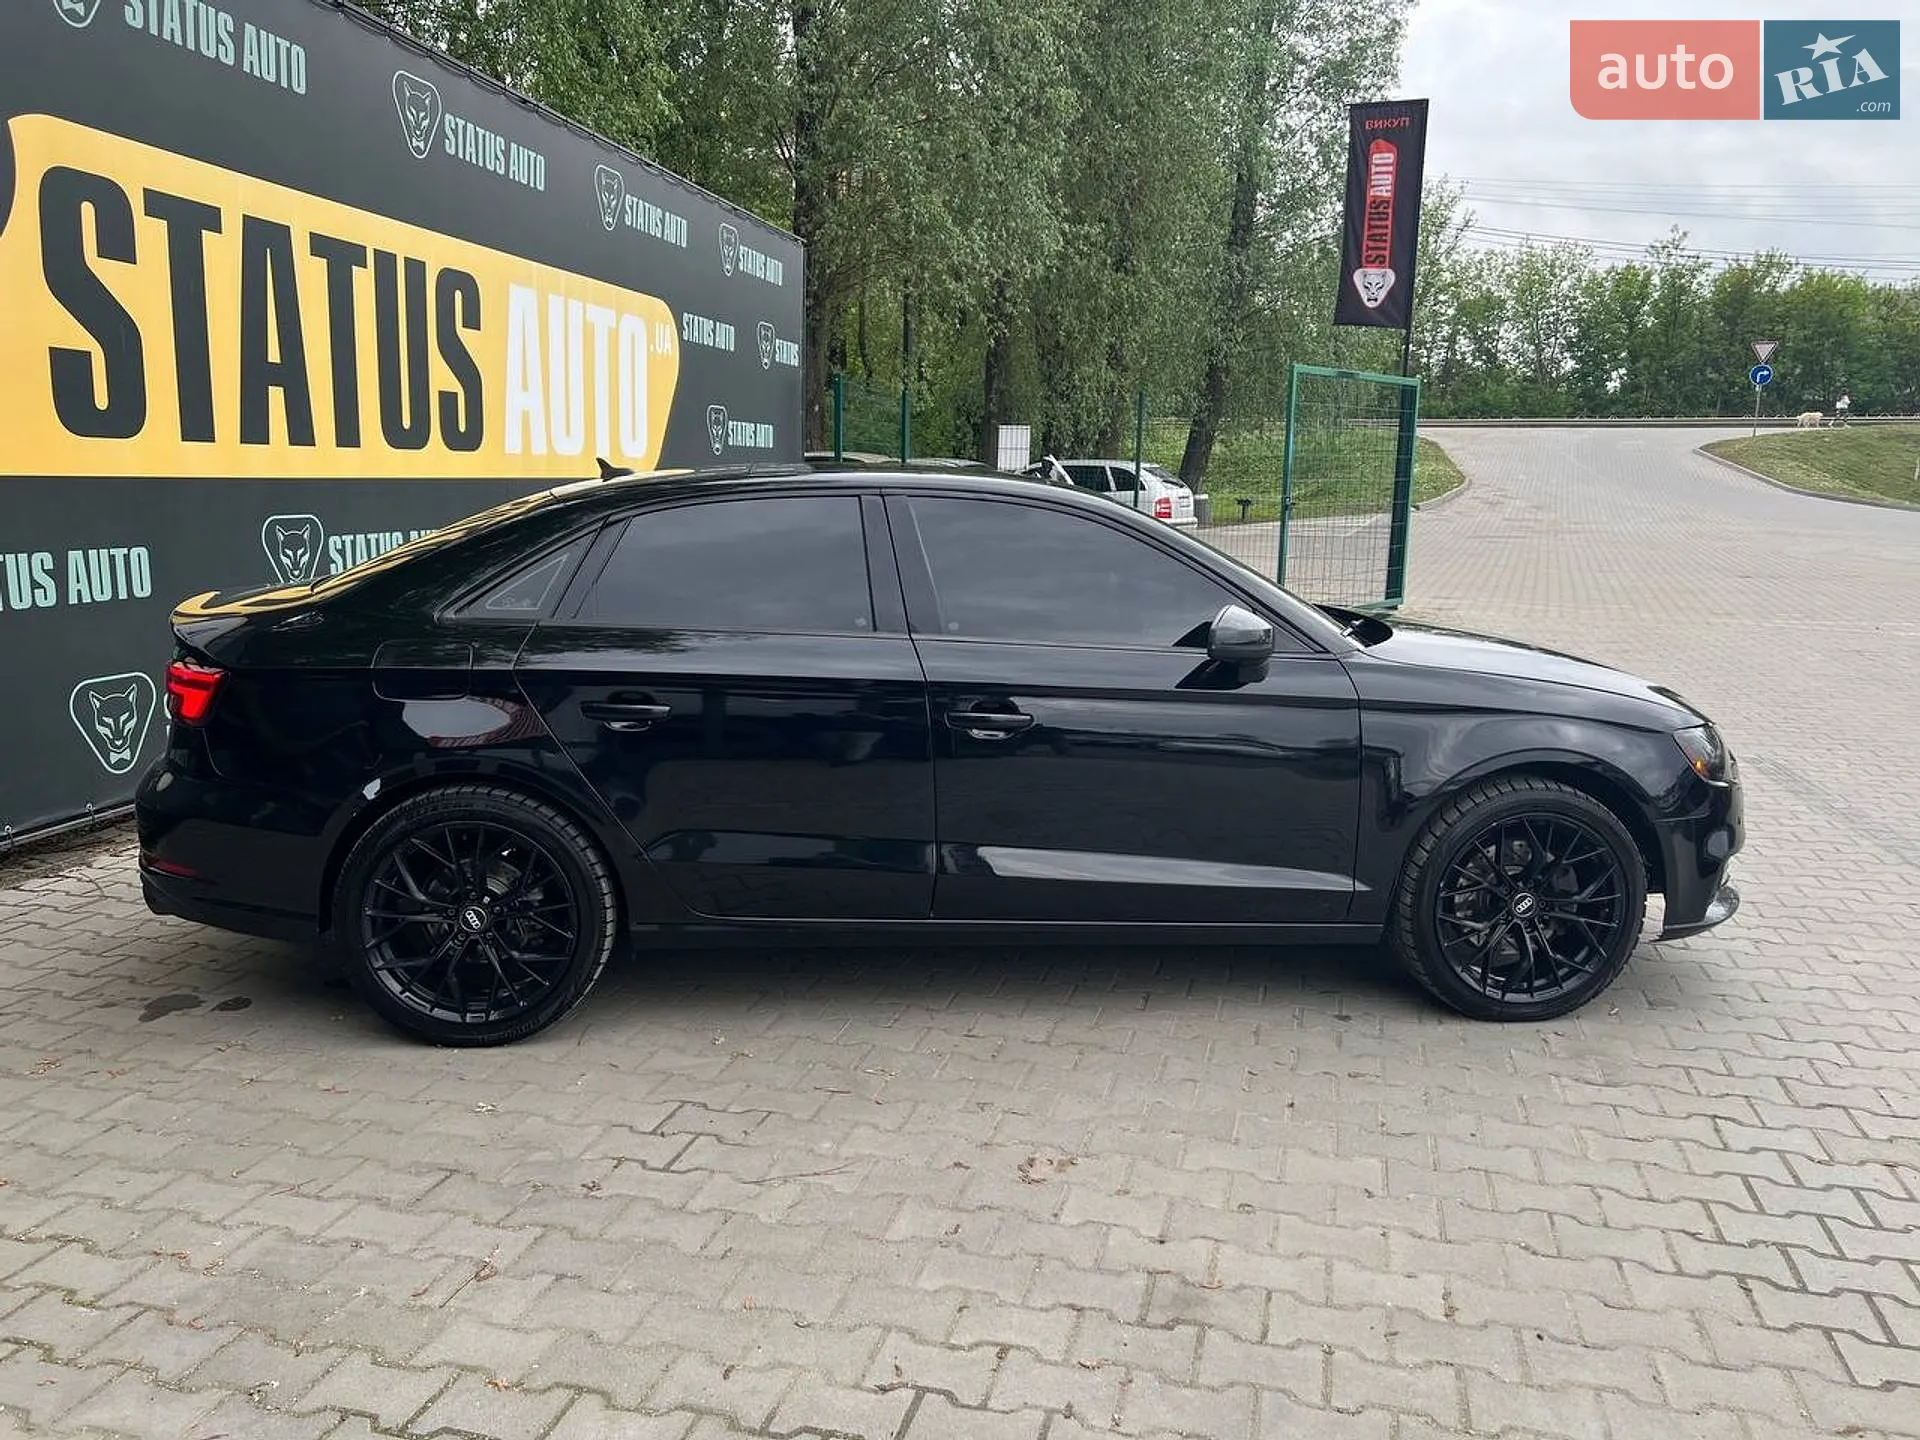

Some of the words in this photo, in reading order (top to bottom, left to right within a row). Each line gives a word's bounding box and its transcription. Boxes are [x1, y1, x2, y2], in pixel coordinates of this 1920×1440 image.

[242, 22, 306, 95] AUTO
[444, 112, 505, 175] STATUS
[509, 142, 545, 191] AUTO
[1370, 153, 1394, 196] AUTO
[625, 194, 662, 239] STATUS
[663, 211, 688, 248] AUTO
[1365, 199, 1390, 265] STATUS
[738, 244, 765, 280] STATUS
[766, 255, 783, 286] AUTO
[38, 165, 484, 452] STATUS
[504, 282, 647, 459] AUTO
[682, 312, 714, 347] STATUS
[715, 321, 735, 352] AUTO
[775, 338, 799, 367] STATUS
[728, 420, 755, 447] STATUS
[756, 423, 774, 449] AUTO
[68, 547, 152, 605] AUTO
